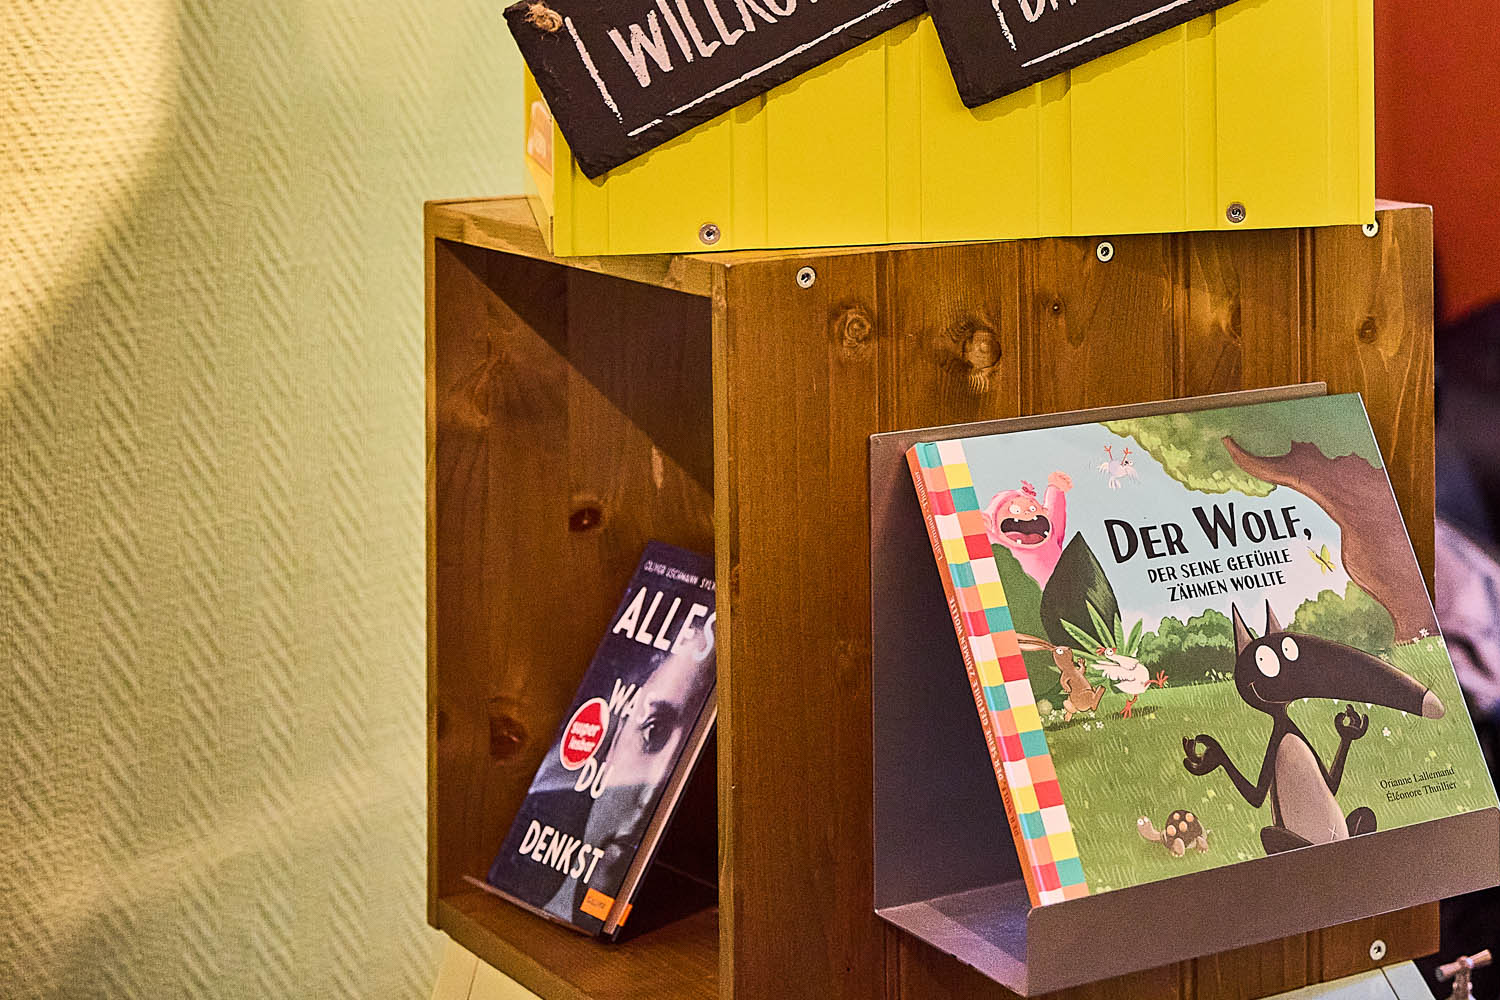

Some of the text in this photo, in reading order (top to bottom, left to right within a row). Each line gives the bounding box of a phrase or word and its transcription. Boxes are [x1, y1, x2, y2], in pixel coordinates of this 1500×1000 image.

[1104, 502, 1312, 563] DER WOLF,
[1147, 548, 1293, 583] DER SEINE GEFÜHLE
[1167, 570, 1286, 602] ZÄHMEN WOLLTE
[612, 586, 717, 661] ALLES
[574, 757, 613, 799] DU
[1379, 766, 1455, 790] Orianne Lallemand
[1386, 781, 1457, 802] Éléonore Thuillier
[518, 819, 605, 884] DENKST
